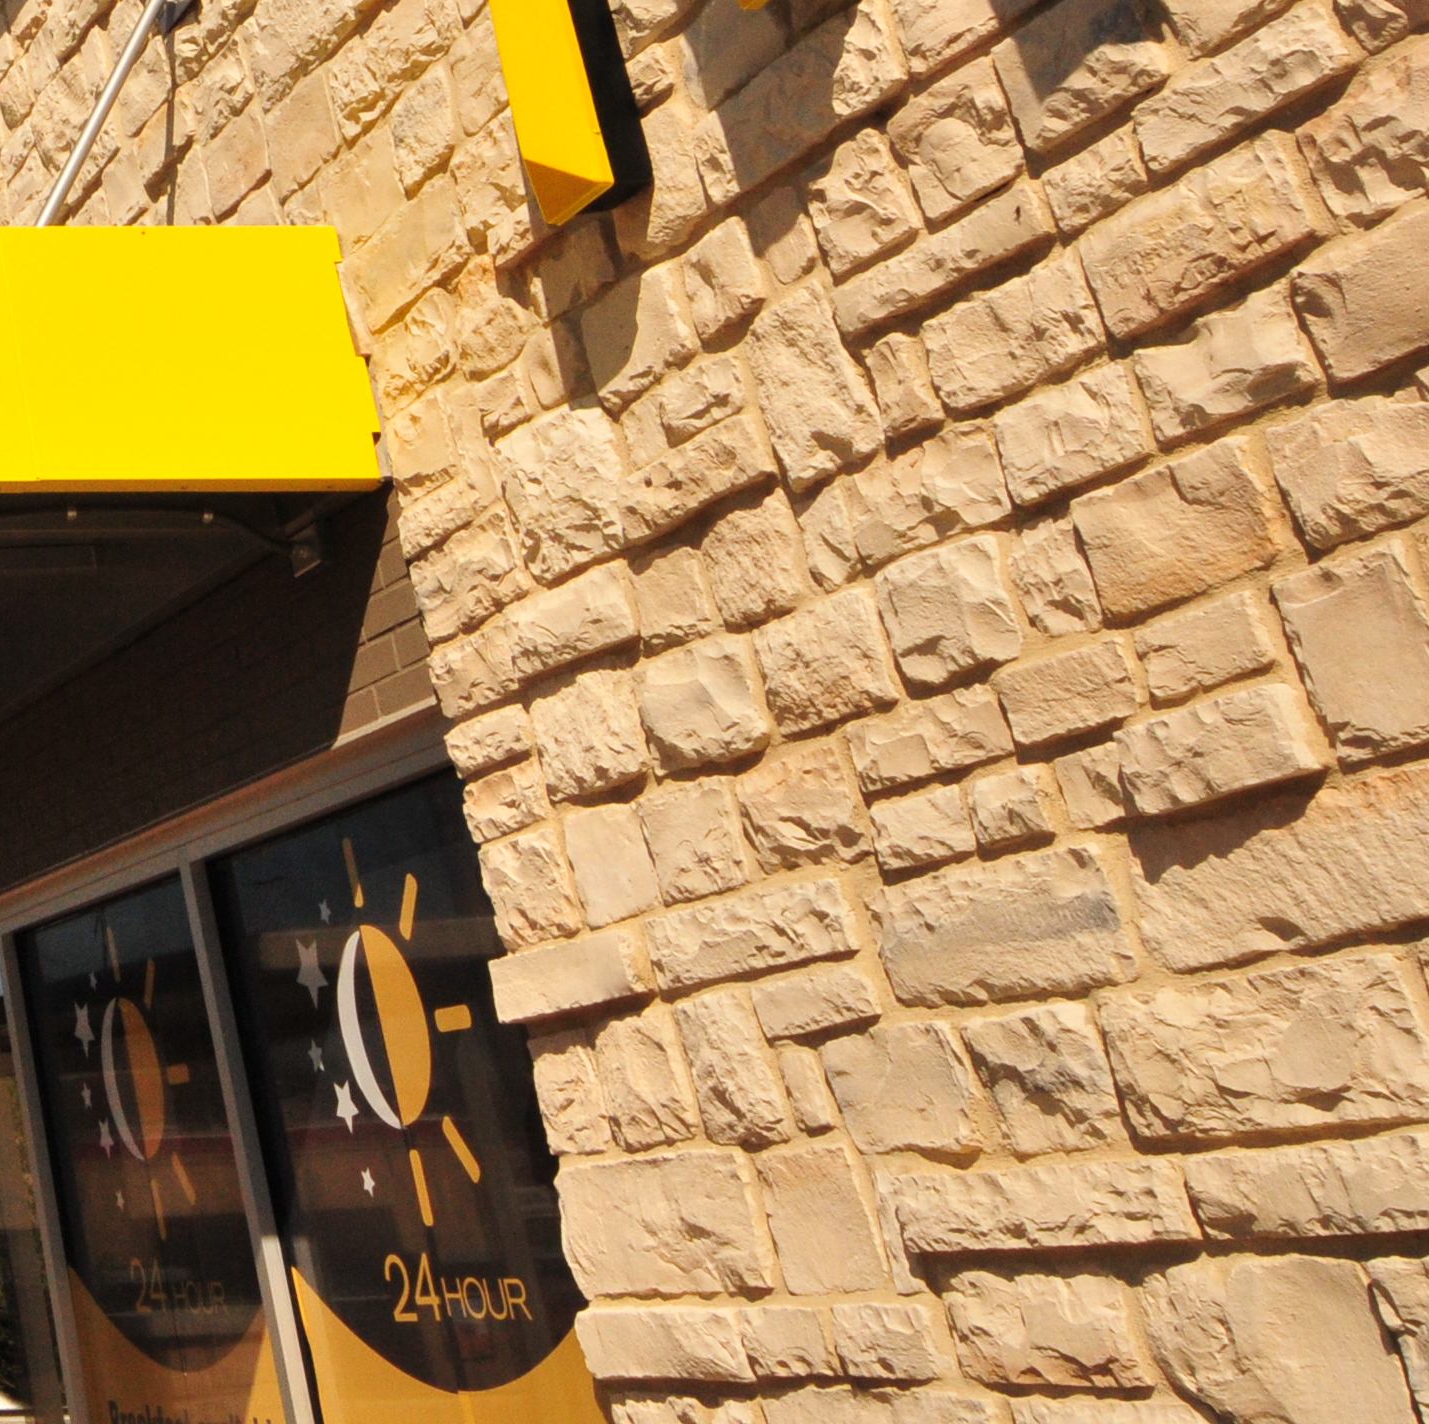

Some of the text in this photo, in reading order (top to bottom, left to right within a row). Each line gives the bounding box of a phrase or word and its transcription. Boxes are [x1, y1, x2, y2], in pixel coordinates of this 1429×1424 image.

[130, 1257, 229, 1315] 24 HOUR
[384, 1252, 533, 1322] 24 HOUR
